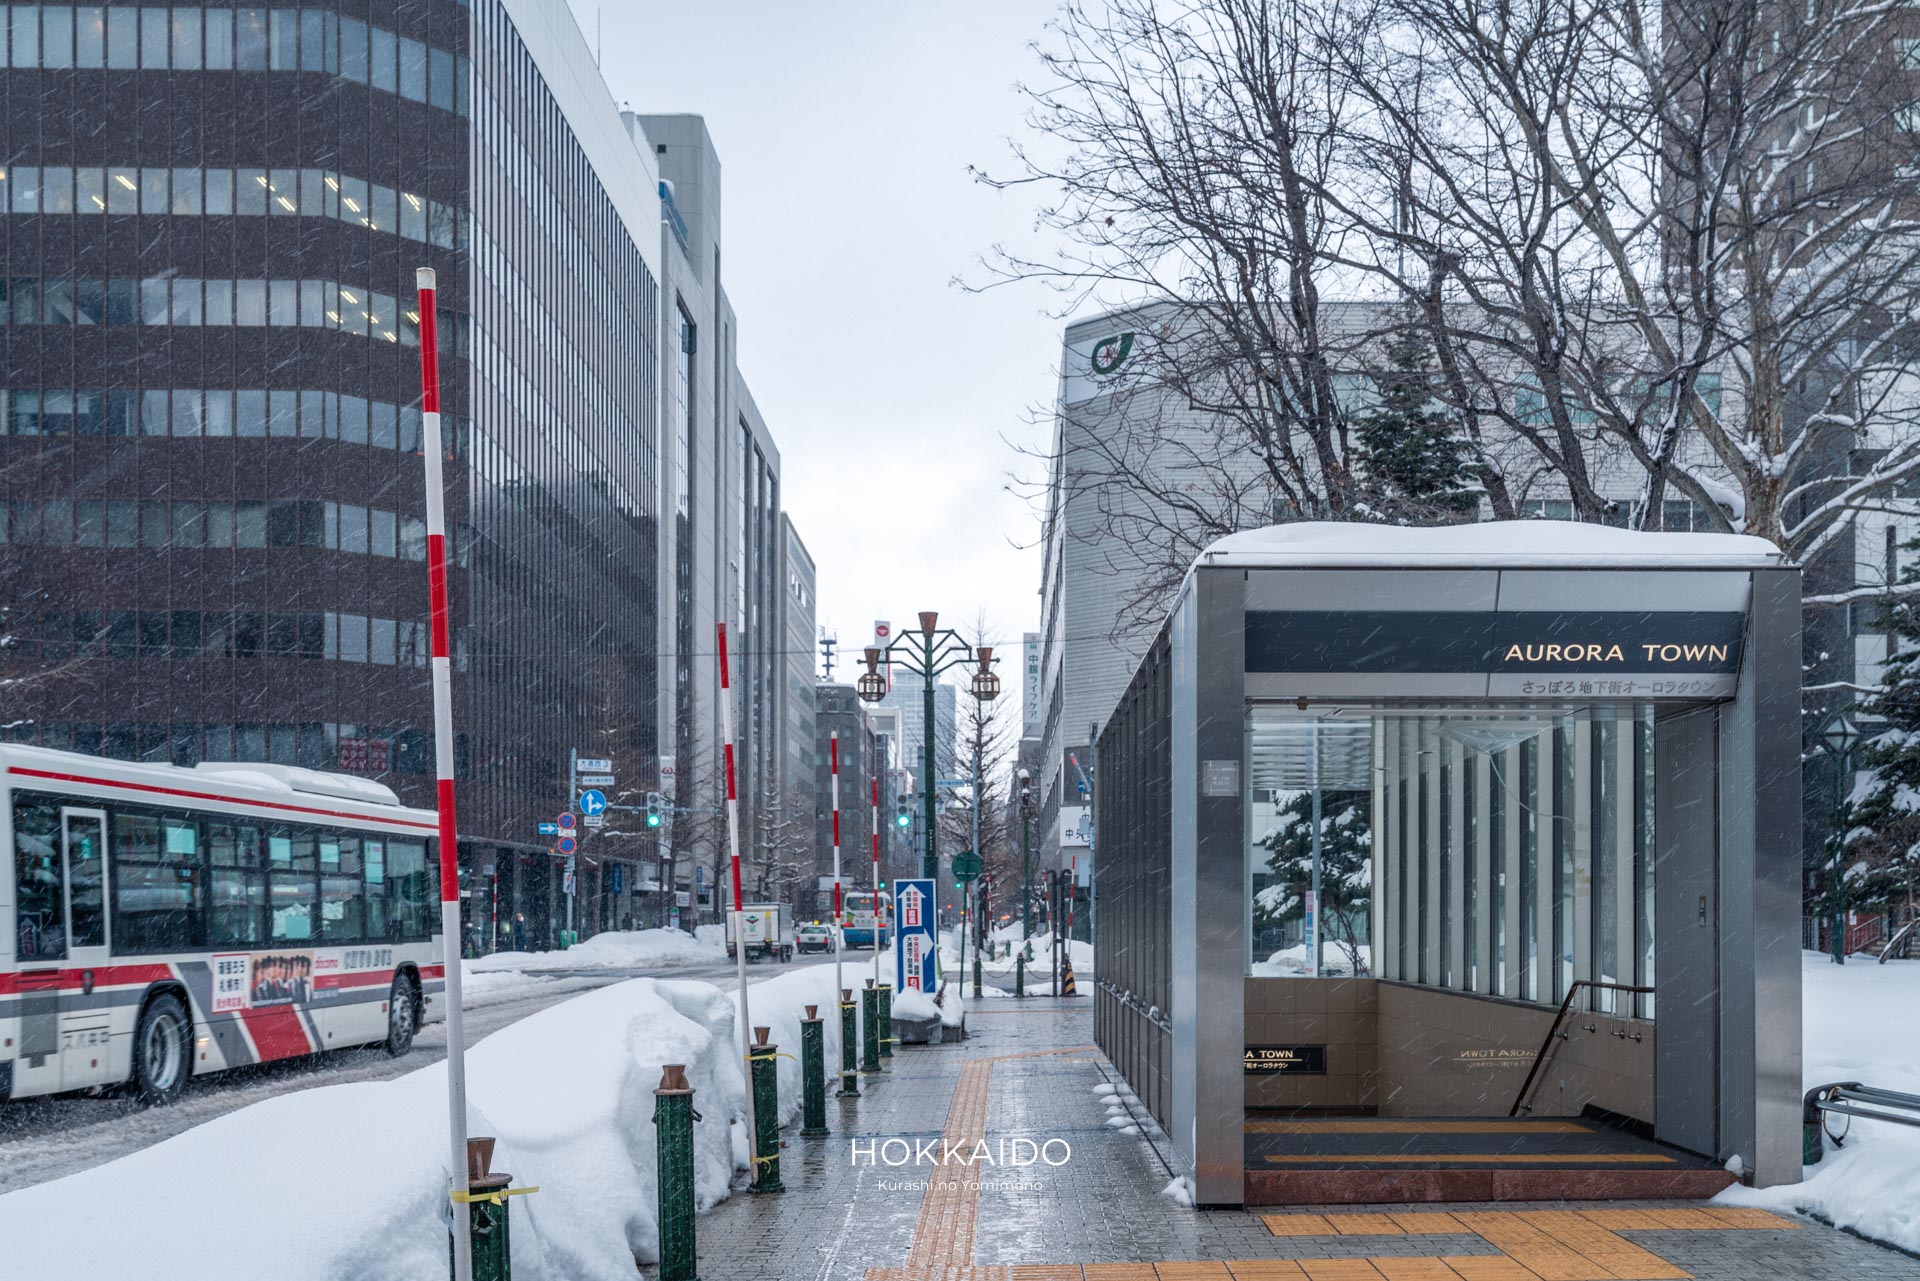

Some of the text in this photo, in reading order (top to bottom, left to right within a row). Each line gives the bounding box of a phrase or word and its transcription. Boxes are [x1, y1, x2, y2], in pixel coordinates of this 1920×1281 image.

[1504, 644, 1728, 662] AURORA TOWN
[1259, 1050, 1293, 1058] TOWN
